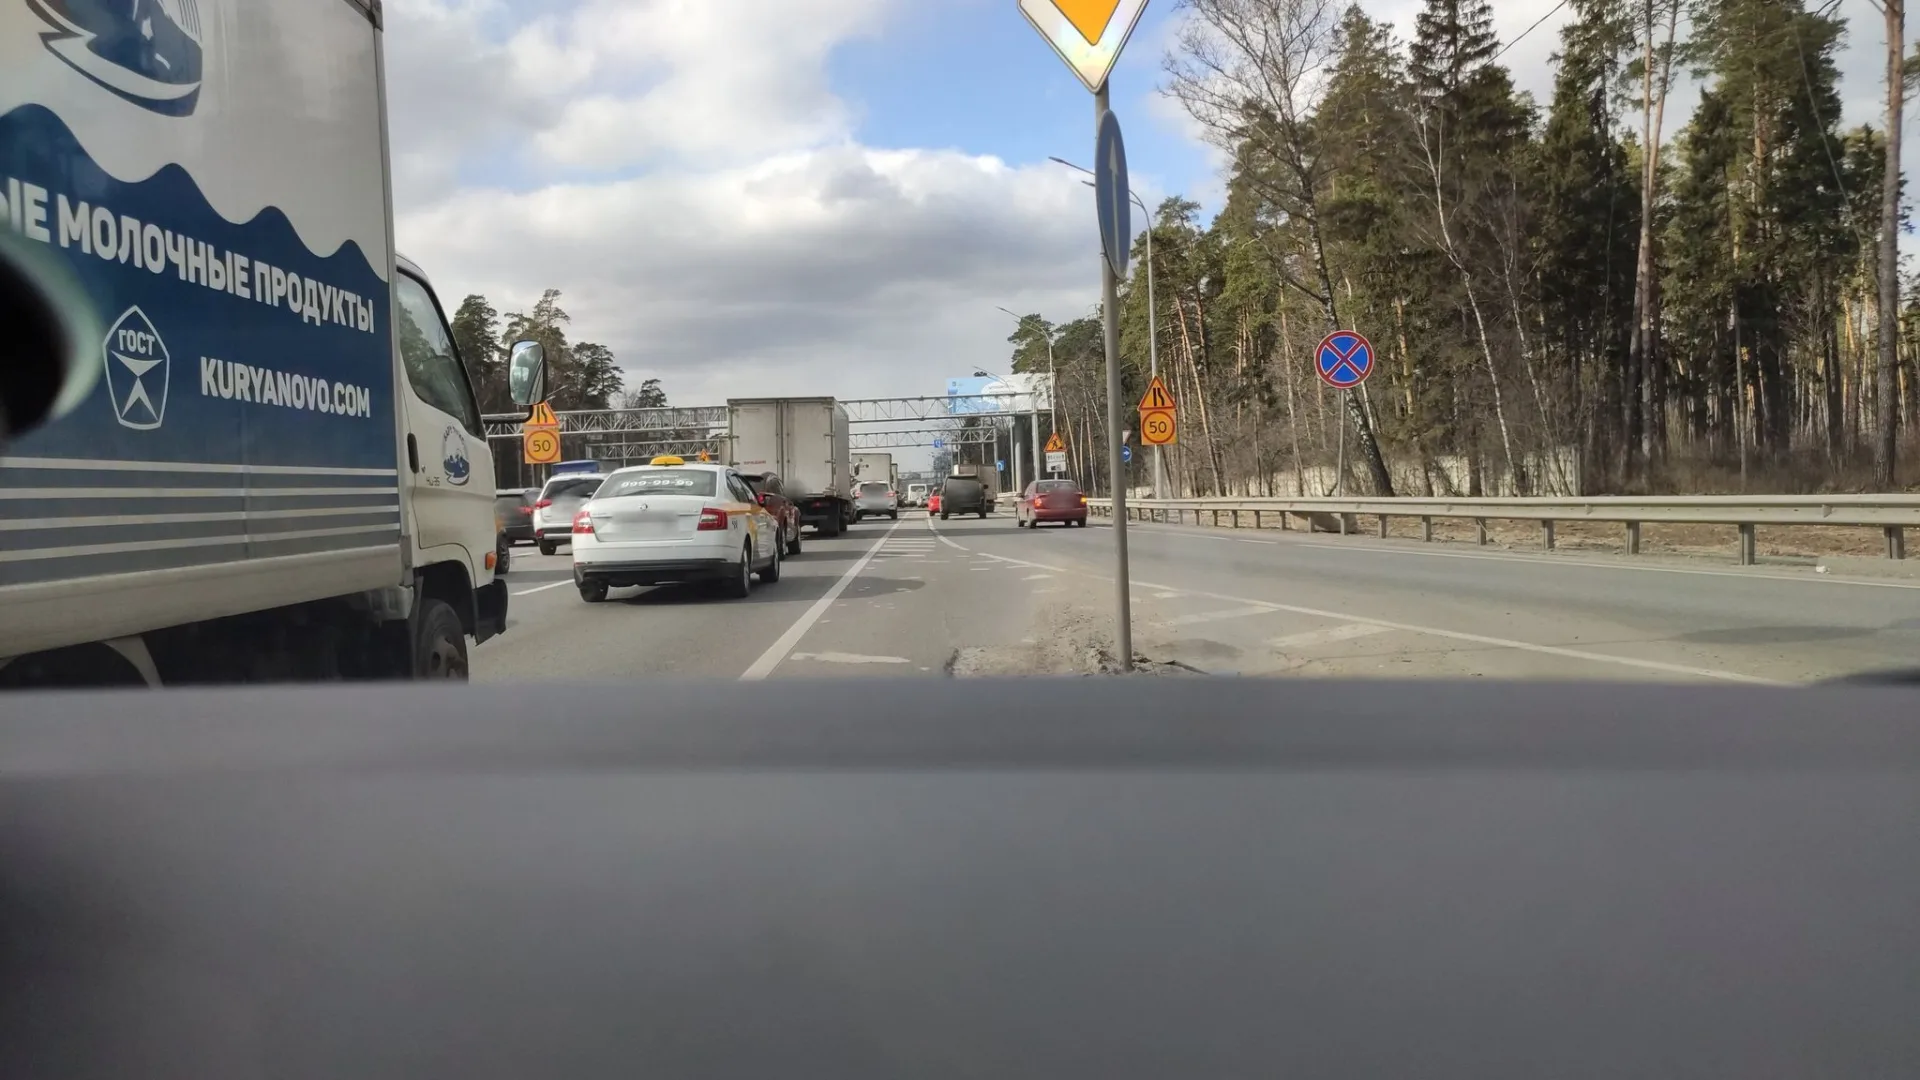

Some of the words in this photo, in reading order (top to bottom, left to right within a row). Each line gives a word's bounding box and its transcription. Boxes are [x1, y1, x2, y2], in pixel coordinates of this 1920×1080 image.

[57, 194, 251, 300] МОЛОЧНЫЕ
[254, 260, 375, 334] ПРОДУКТЫ
[118, 329, 155, 356] ГОСТ
[200, 356, 371, 418] KURYANOVO.COM
[1149, 422, 1167, 433] 50
[533, 440, 551, 453] 50
